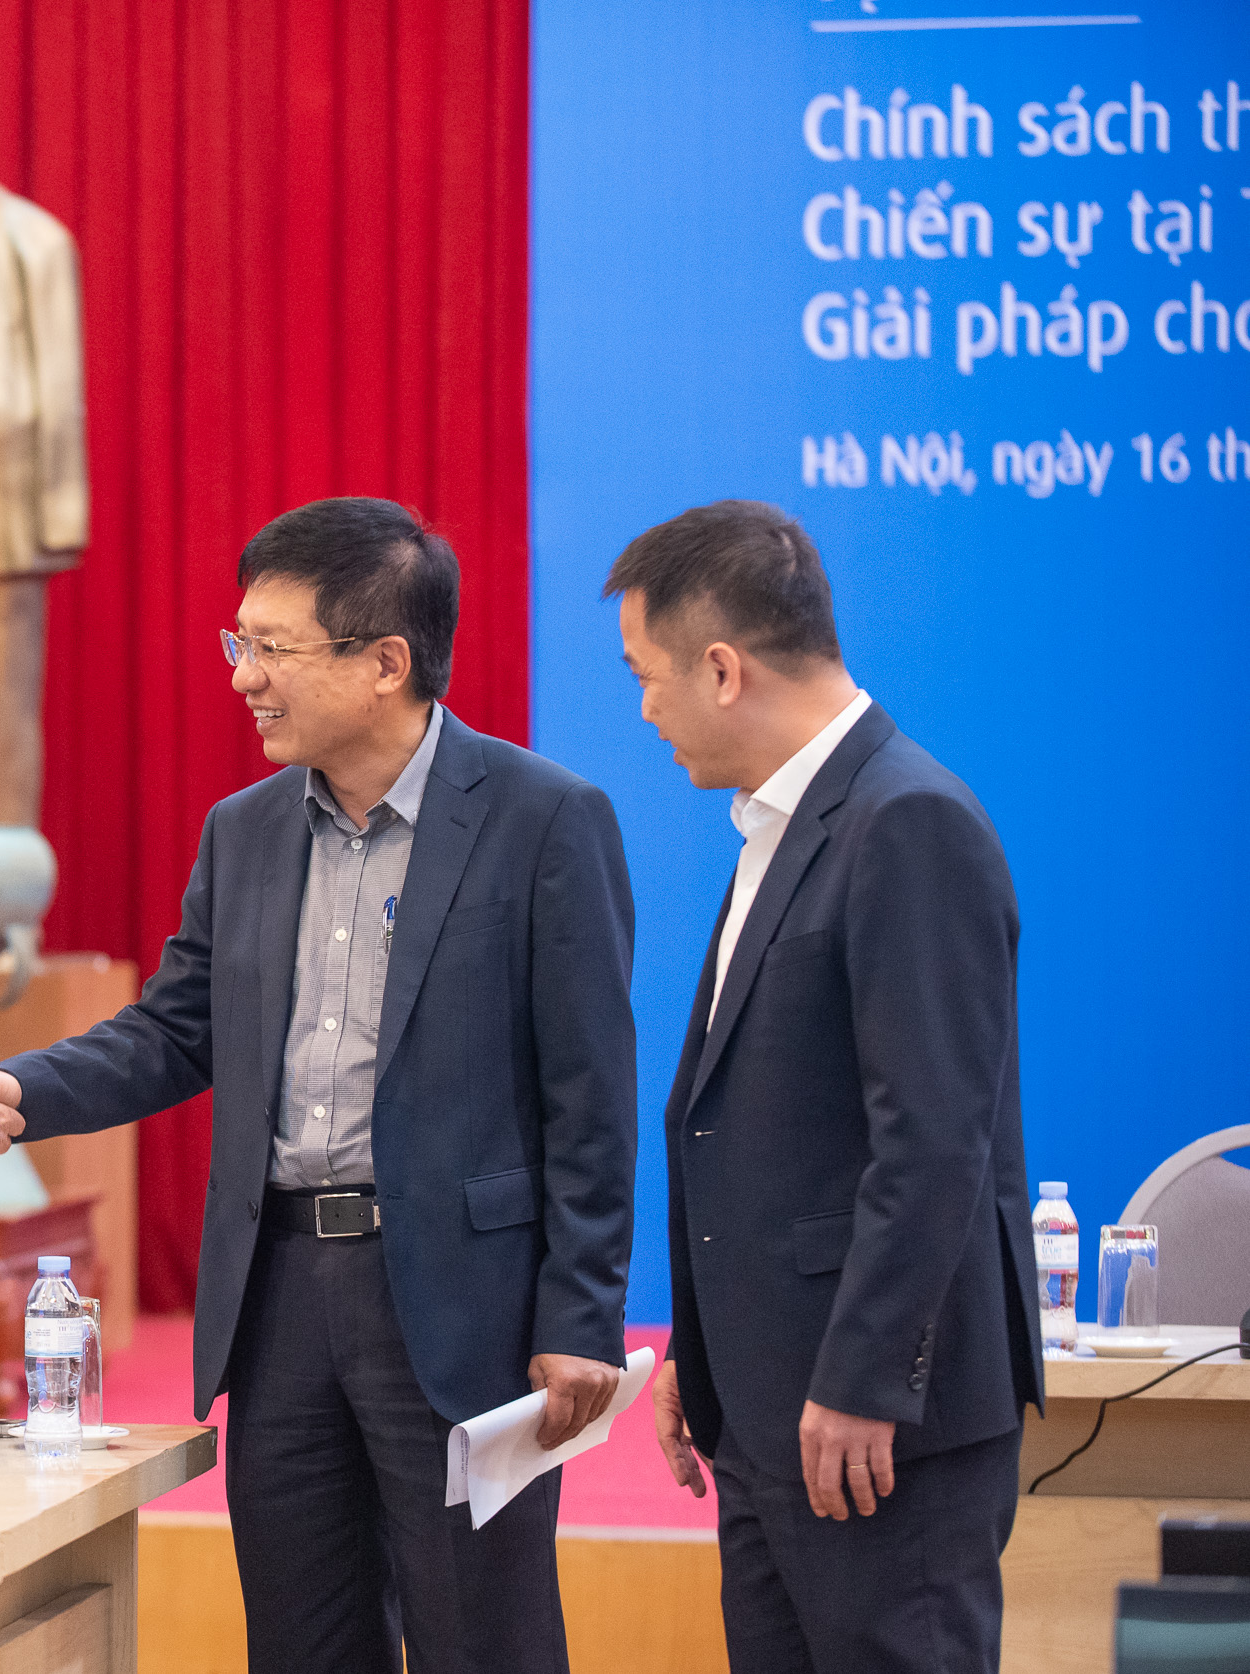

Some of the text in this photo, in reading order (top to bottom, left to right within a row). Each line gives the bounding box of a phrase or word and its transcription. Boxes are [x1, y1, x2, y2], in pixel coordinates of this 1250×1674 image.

[803, 83, 994, 162] Chính
[1017, 80, 1171, 157] sách
[802, 181, 1214, 269] Chiến sự tại
[802, 285, 932, 361] Giải
[956, 281, 1130, 377] pháp
[802, 431, 868, 489] Hà
[880, 431, 978, 497] Nội,
[992, 428, 1114, 499] ngày
[1131, 432, 1192, 484] 16
